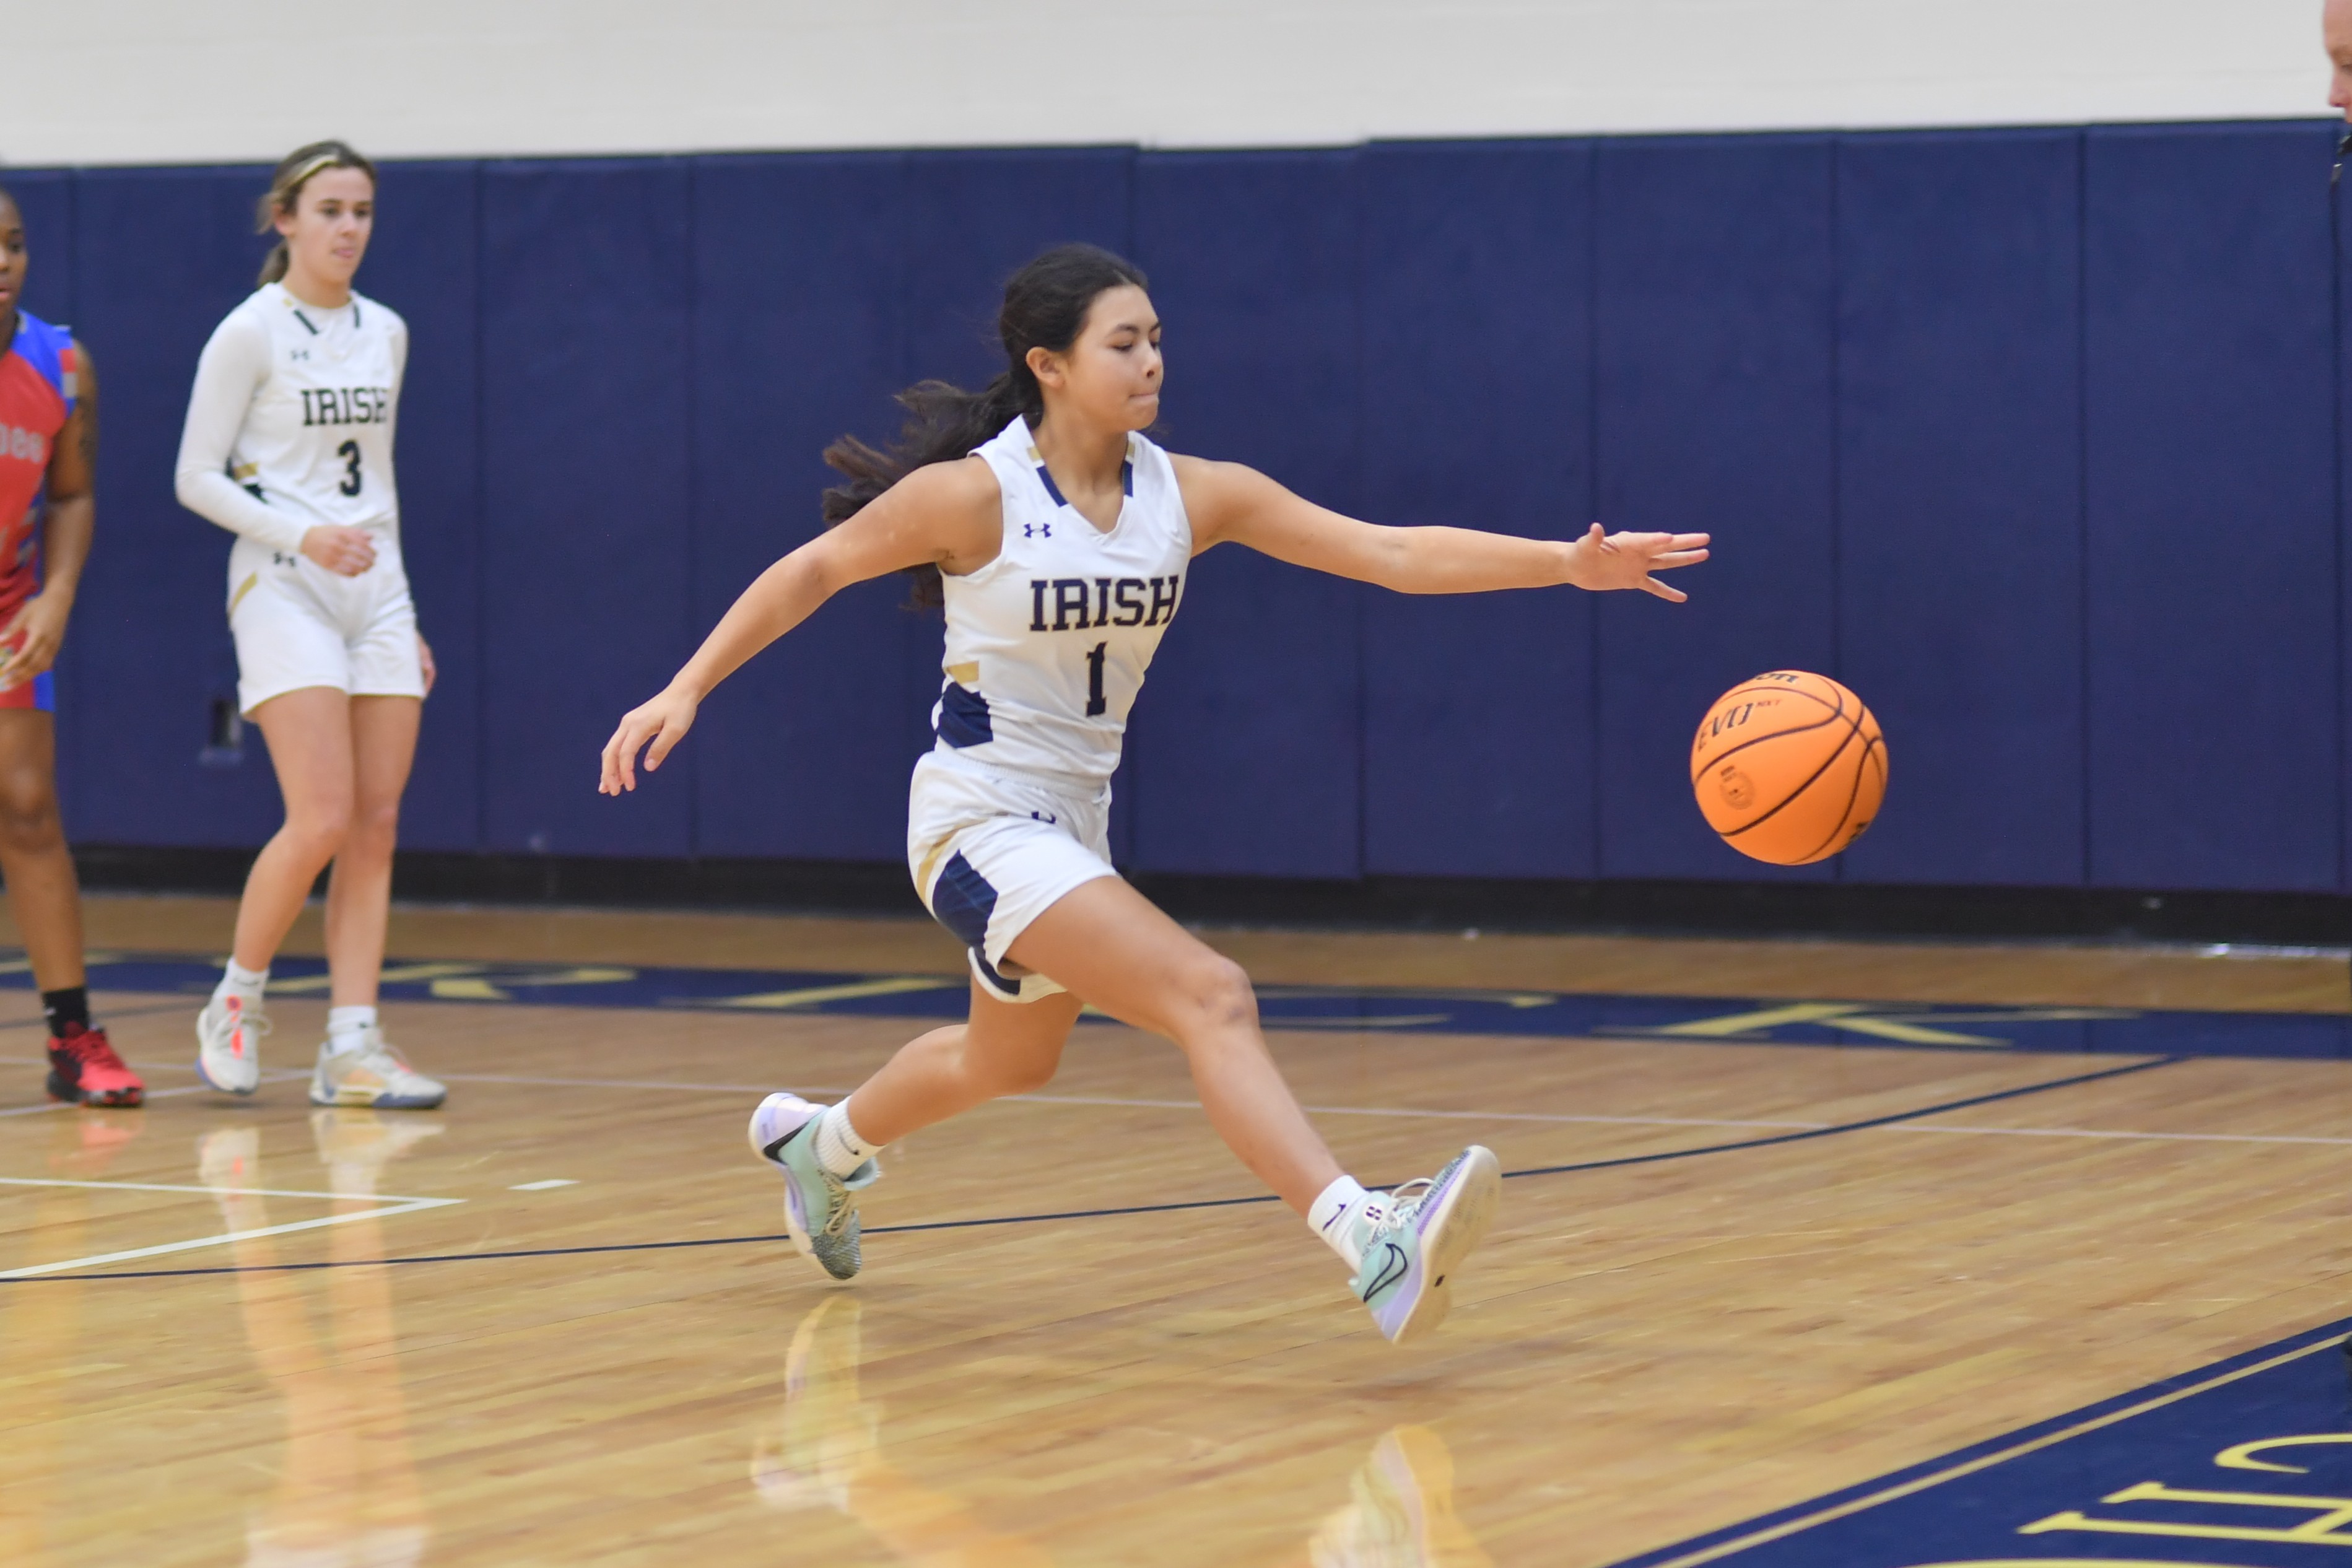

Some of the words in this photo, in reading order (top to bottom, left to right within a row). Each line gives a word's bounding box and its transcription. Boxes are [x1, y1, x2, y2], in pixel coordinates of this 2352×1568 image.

[338, 439, 362, 497] 3
[1029, 574, 1179, 632] IRISH
[1086, 641, 1108, 717] 1
